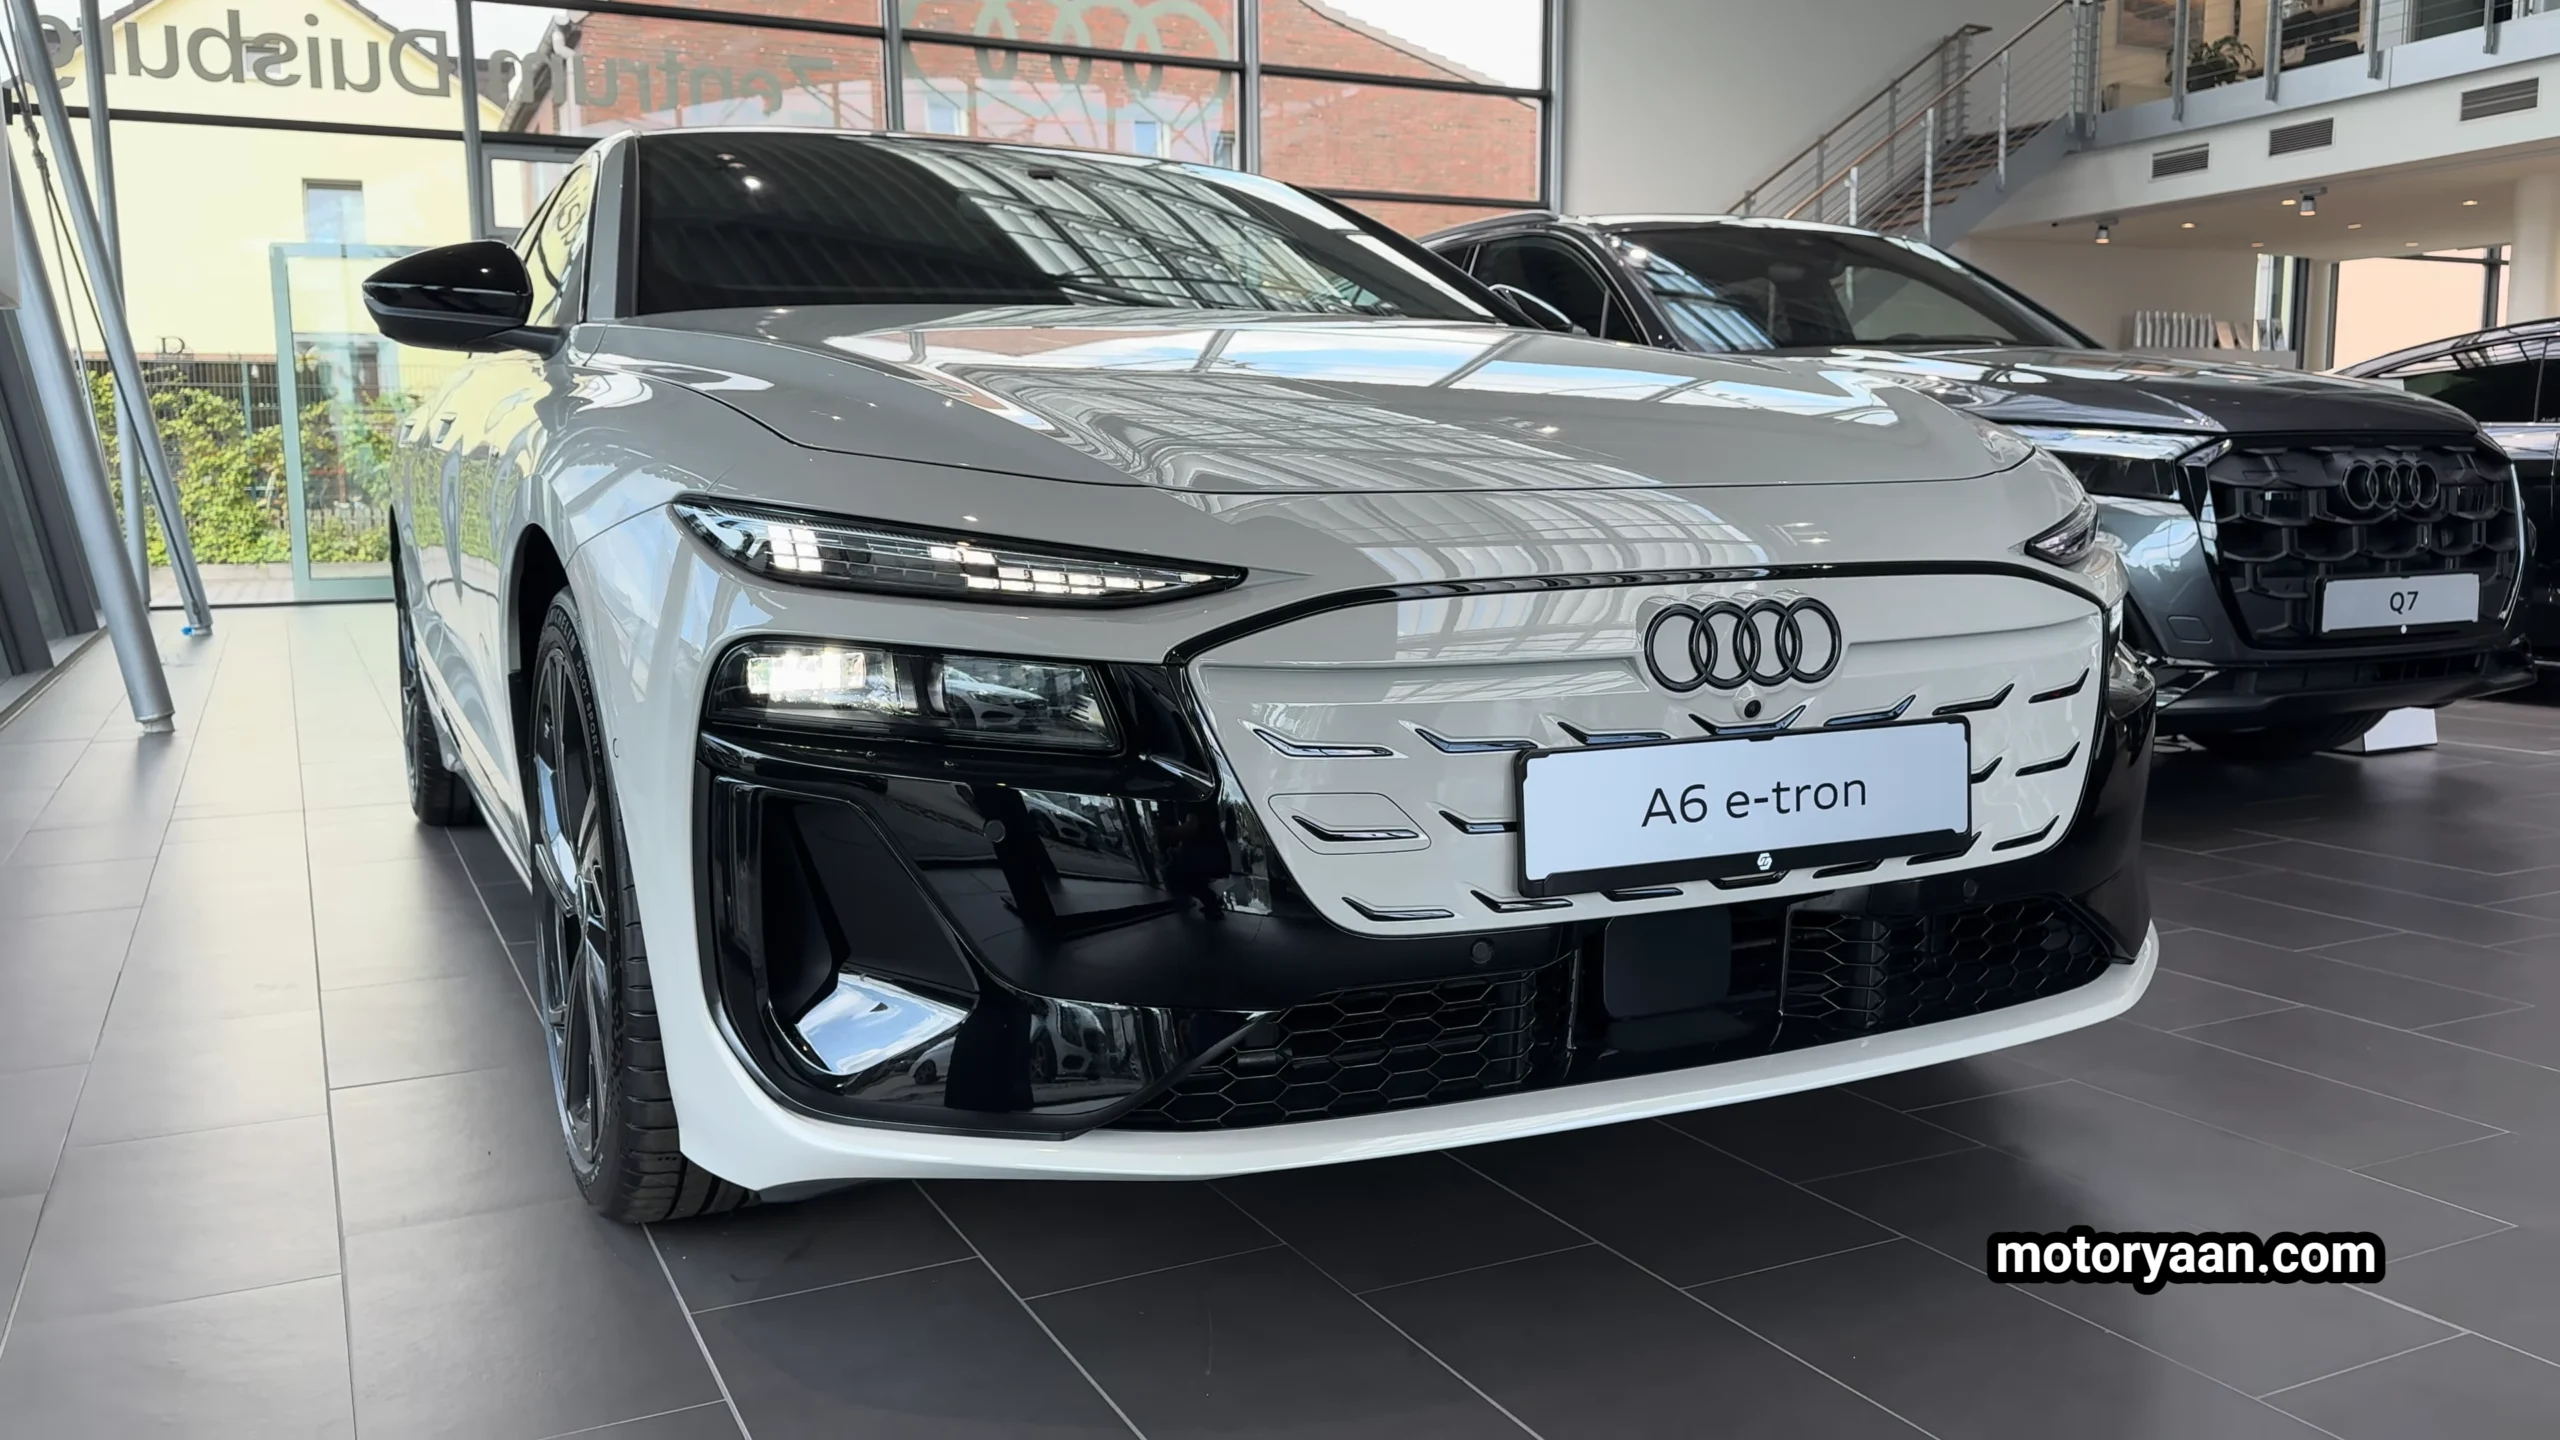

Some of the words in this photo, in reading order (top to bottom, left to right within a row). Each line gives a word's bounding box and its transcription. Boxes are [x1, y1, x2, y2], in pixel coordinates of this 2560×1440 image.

[2389, 591, 2419, 614] Q7
[576, 660, 590, 697] PILOT
[586, 702, 600, 756] SPORT
[1641, 784, 1708, 827] A6
[1726, 779, 1866, 819] e-tron
